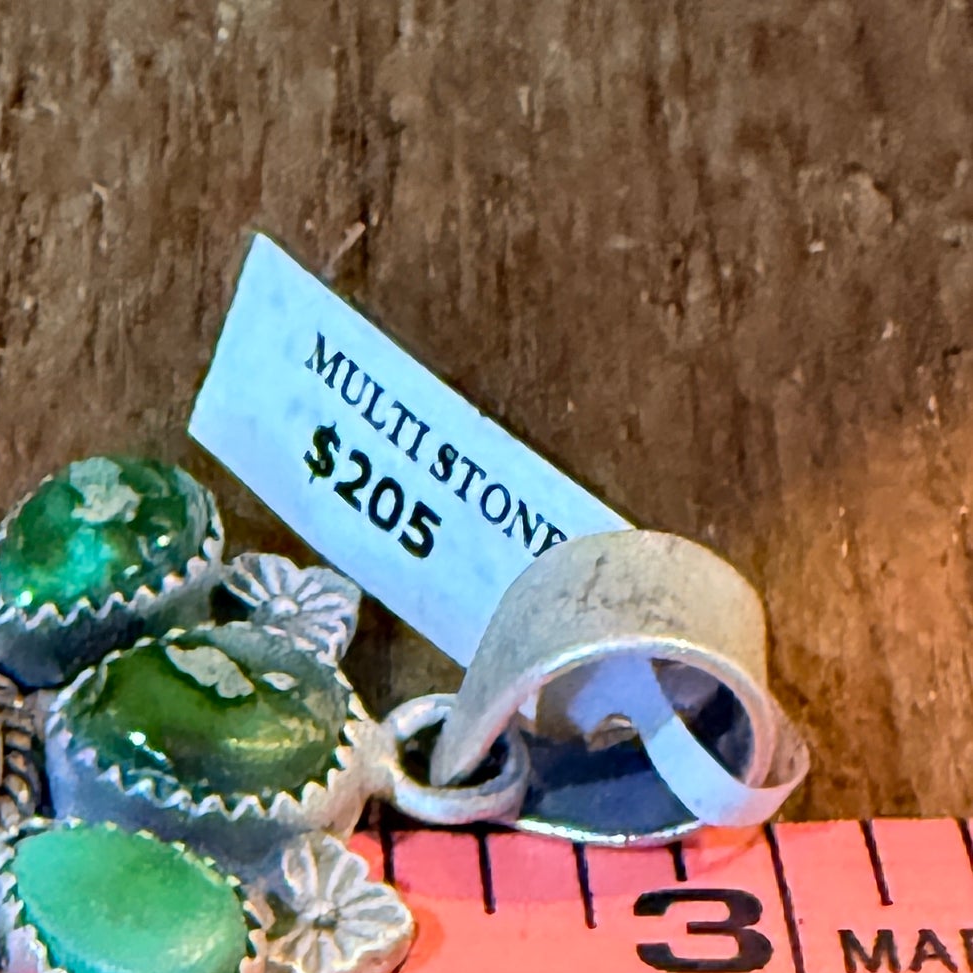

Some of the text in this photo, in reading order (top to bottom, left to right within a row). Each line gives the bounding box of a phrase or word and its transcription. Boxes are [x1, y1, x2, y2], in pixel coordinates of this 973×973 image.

[304, 331, 431, 463] MULTI
[302, 419, 443, 559] $205
[633, 888, 775, 973] 3
